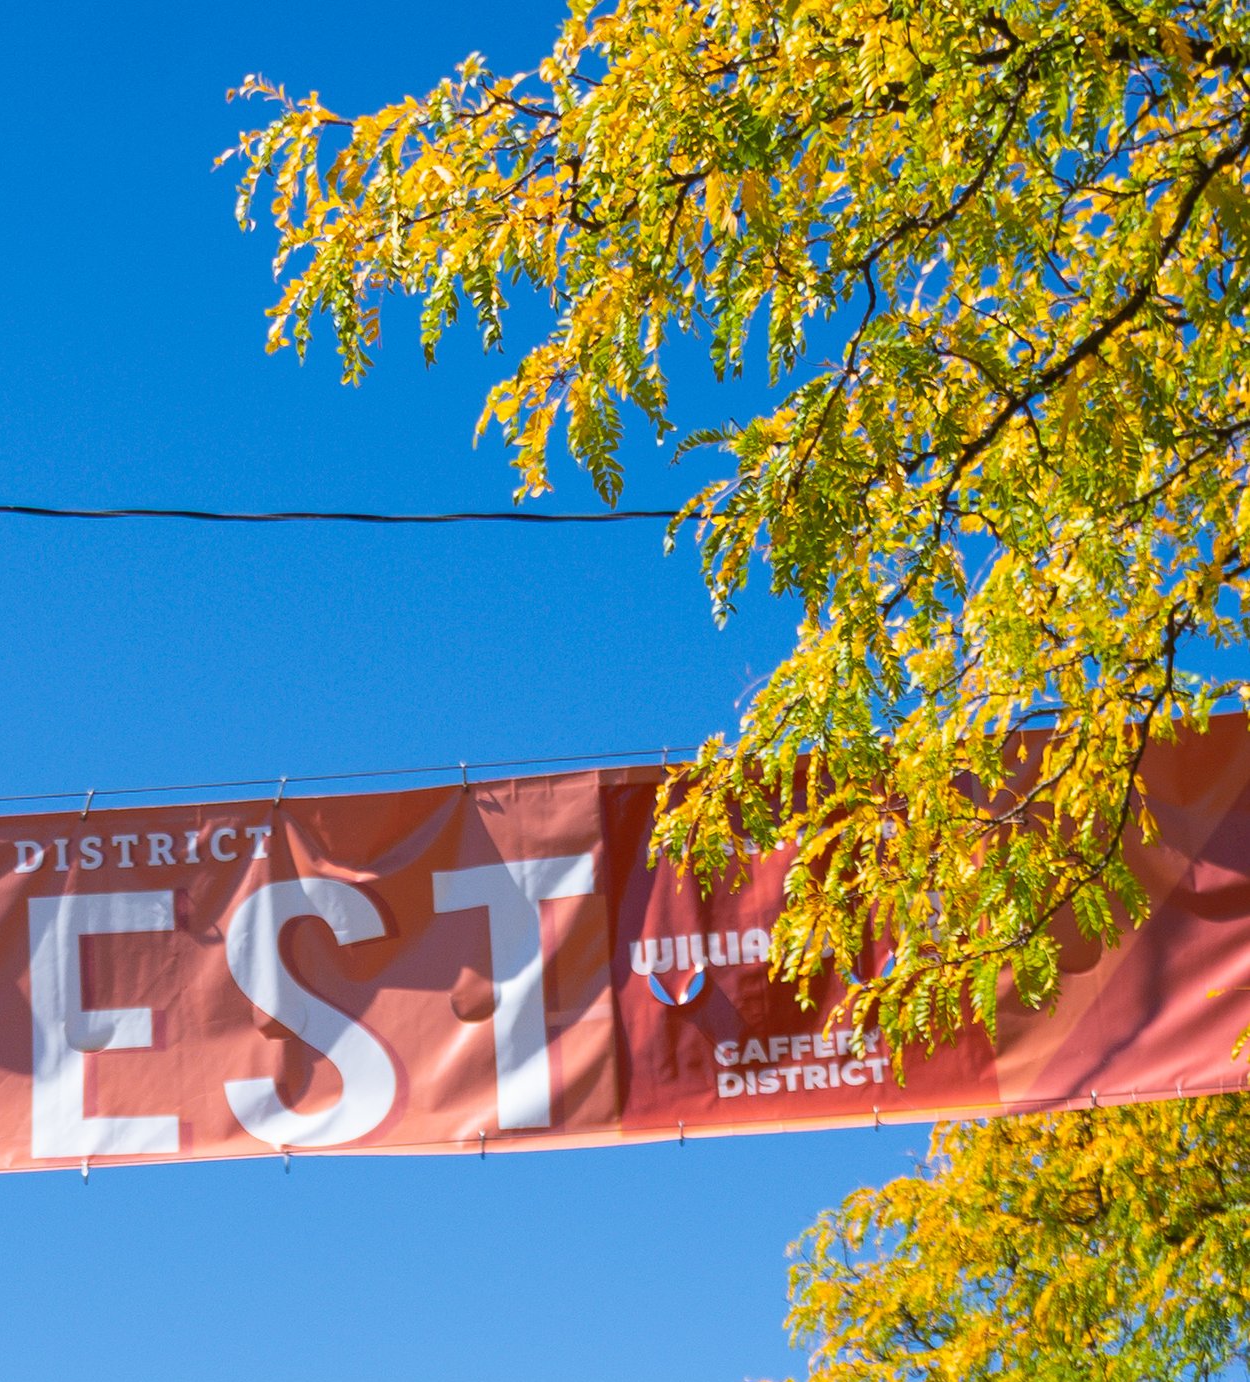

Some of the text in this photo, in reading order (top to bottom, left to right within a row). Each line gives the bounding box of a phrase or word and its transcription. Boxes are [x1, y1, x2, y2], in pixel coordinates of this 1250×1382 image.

[14, 824, 273, 875] DISTRICT
[629, 927, 836, 976] WILLIA
[716, 1057, 889, 1099] DISTRICT
